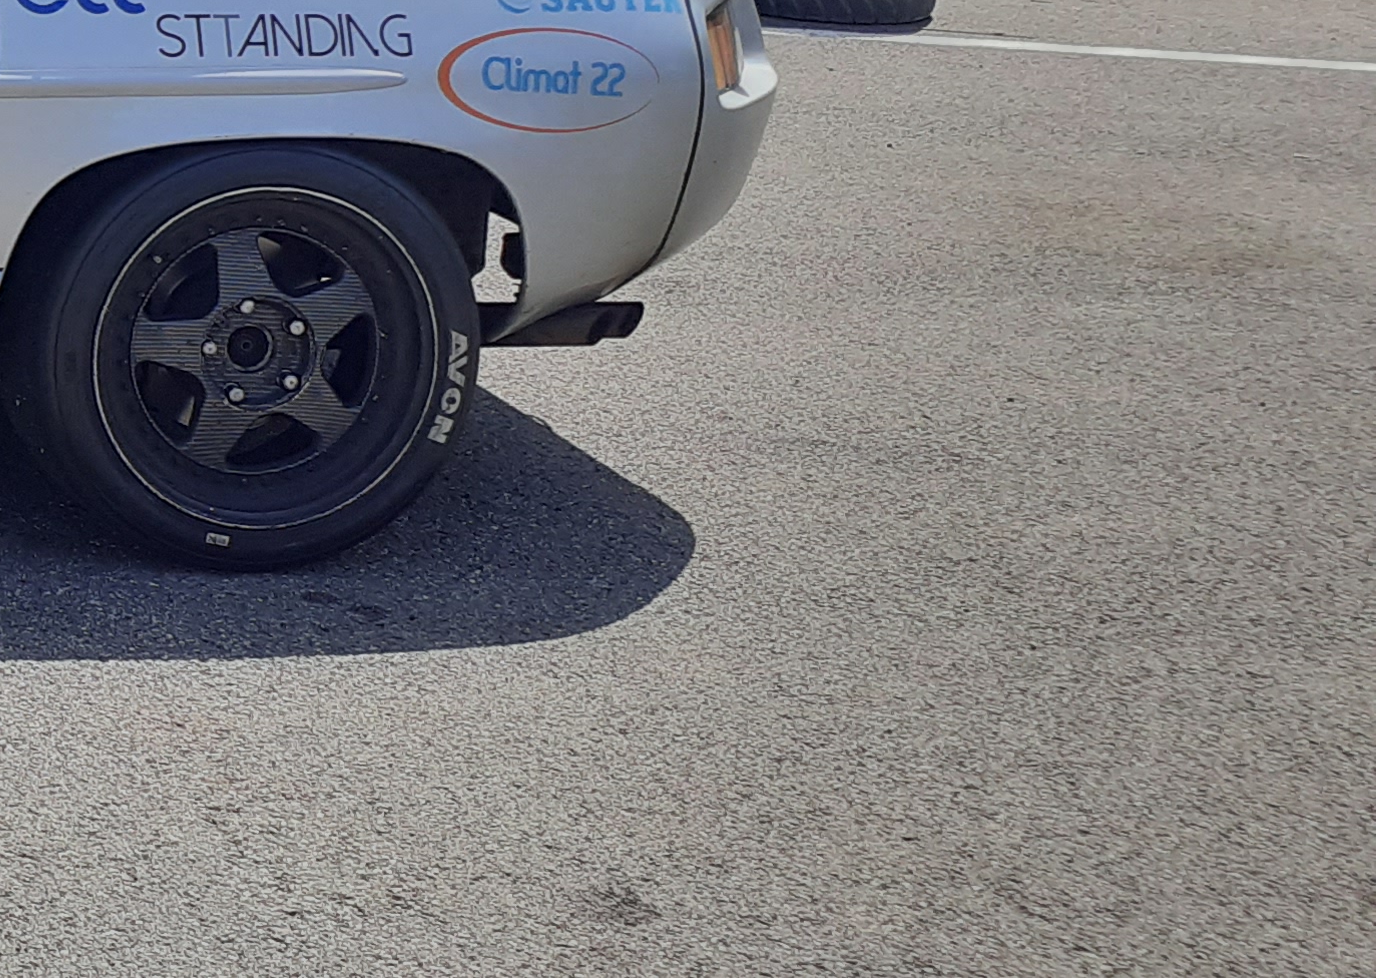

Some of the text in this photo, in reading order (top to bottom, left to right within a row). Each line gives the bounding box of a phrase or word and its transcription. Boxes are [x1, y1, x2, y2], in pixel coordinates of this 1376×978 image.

[156, 13, 414, 57] STTANDING
[481, 56, 626, 97] Climat 22
[427, 329, 469, 444] AVON
